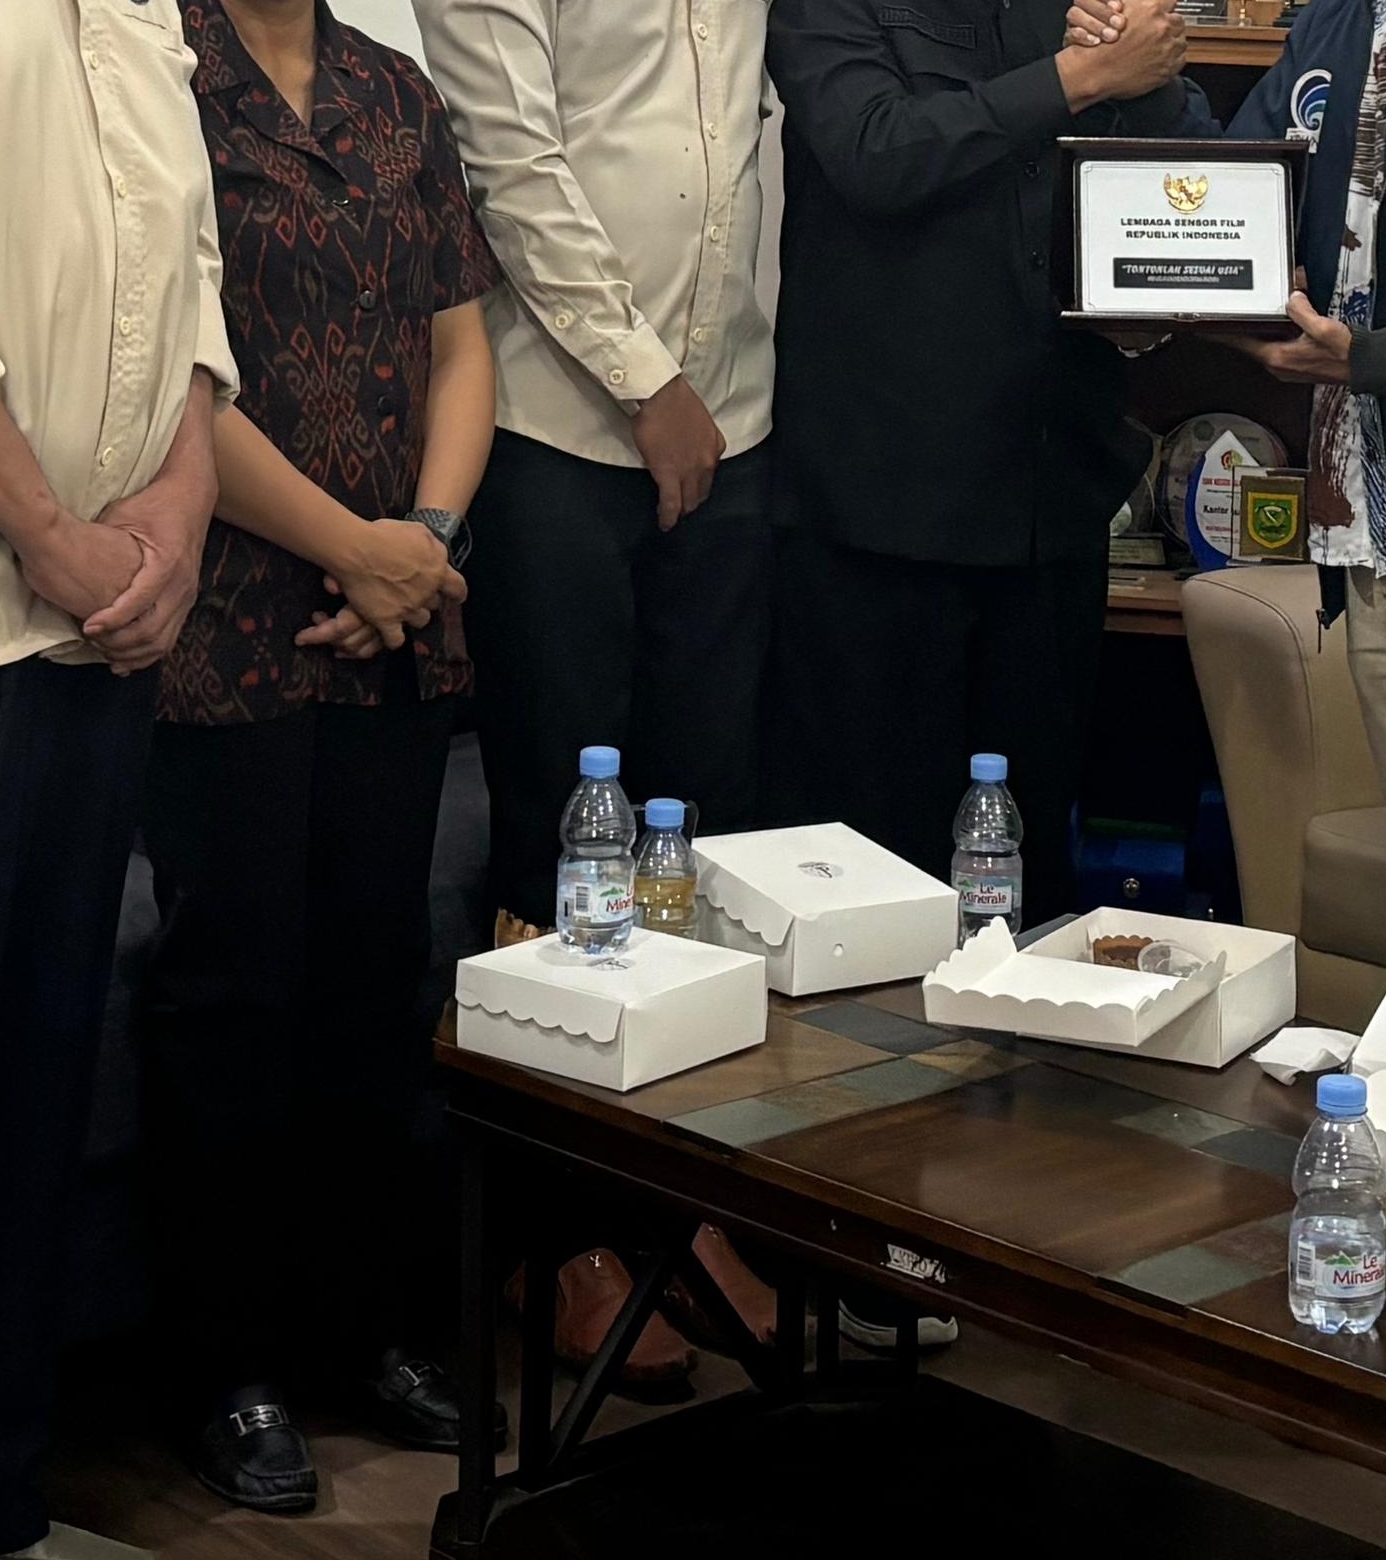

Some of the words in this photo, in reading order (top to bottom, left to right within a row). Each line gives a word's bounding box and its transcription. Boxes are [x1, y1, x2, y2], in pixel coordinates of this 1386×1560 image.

[1120, 218, 1171, 226] LEMBAGA
[1174, 219, 1217, 227] SENSOR
[1126, 231, 1179, 239] REPUBLIK
[1182, 232, 1241, 240] INDONESIA
[980, 883, 994, 894] Le
[959, 890, 1007, 904] Minerale
[1363, 1254, 1378, 1269] Le
